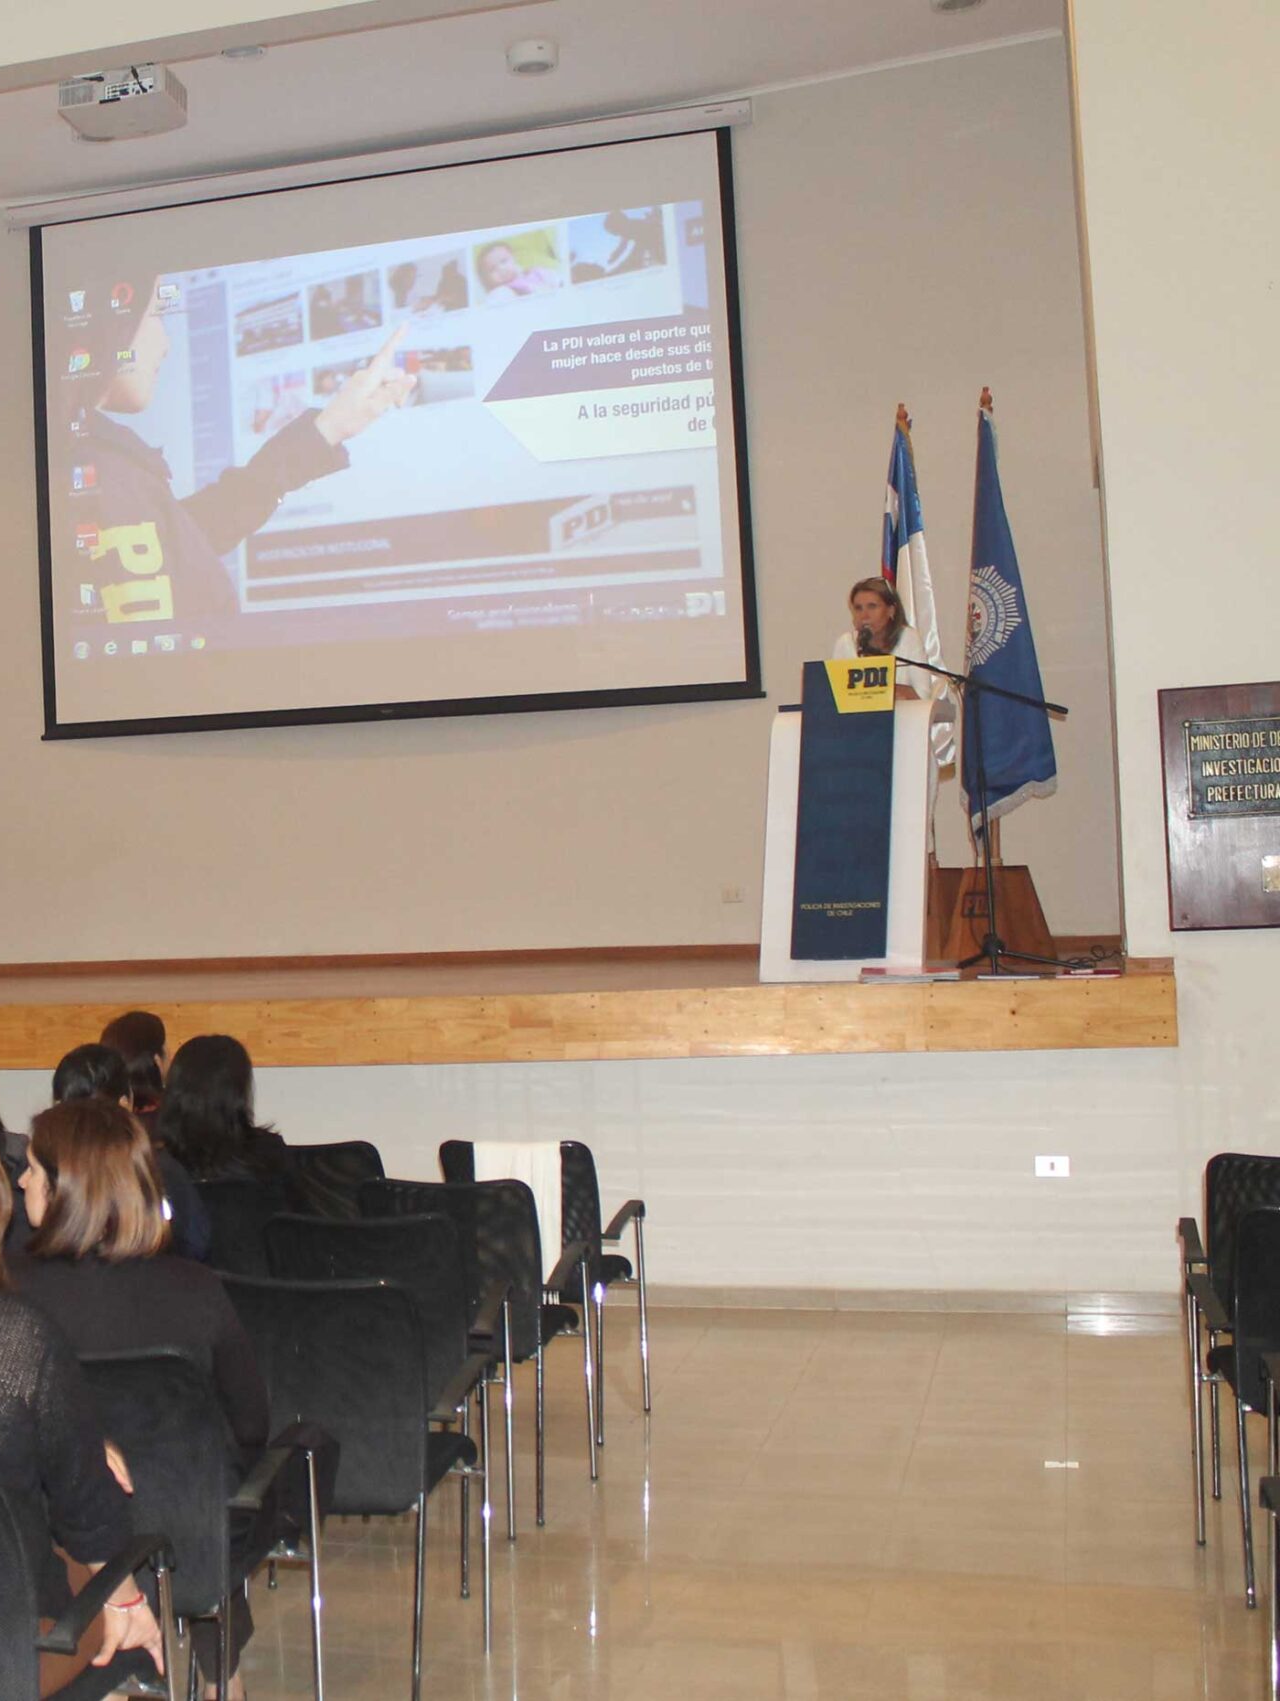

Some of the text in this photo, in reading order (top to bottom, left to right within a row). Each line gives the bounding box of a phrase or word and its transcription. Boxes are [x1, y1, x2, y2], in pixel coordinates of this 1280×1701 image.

[543, 340, 558, 352] La
[562, 335, 583, 350] PDI
[587, 331, 625, 348] valora
[629, 328, 641, 343] el
[645, 325, 687, 342] aporte
[551, 353, 587, 370] mujer
[591, 348, 622, 364] hace
[625, 344, 664, 361] desde
[667, 344, 691, 356] sus
[631, 361, 682, 380] puestos
[686, 359, 702, 372] de
[577, 405, 589, 420] A
[593, 403, 607, 418] la
[612, 394, 690, 418] seguridad
[687, 416, 707, 432] de
[846, 666, 888, 690] PDI
[1190, 732, 1250, 752] MINISTERIO
[1252, 731, 1268, 748] DE
[1202, 757, 1280, 777] INVESTIGACIO
[1207, 783, 1280, 802] PREFECTURA
